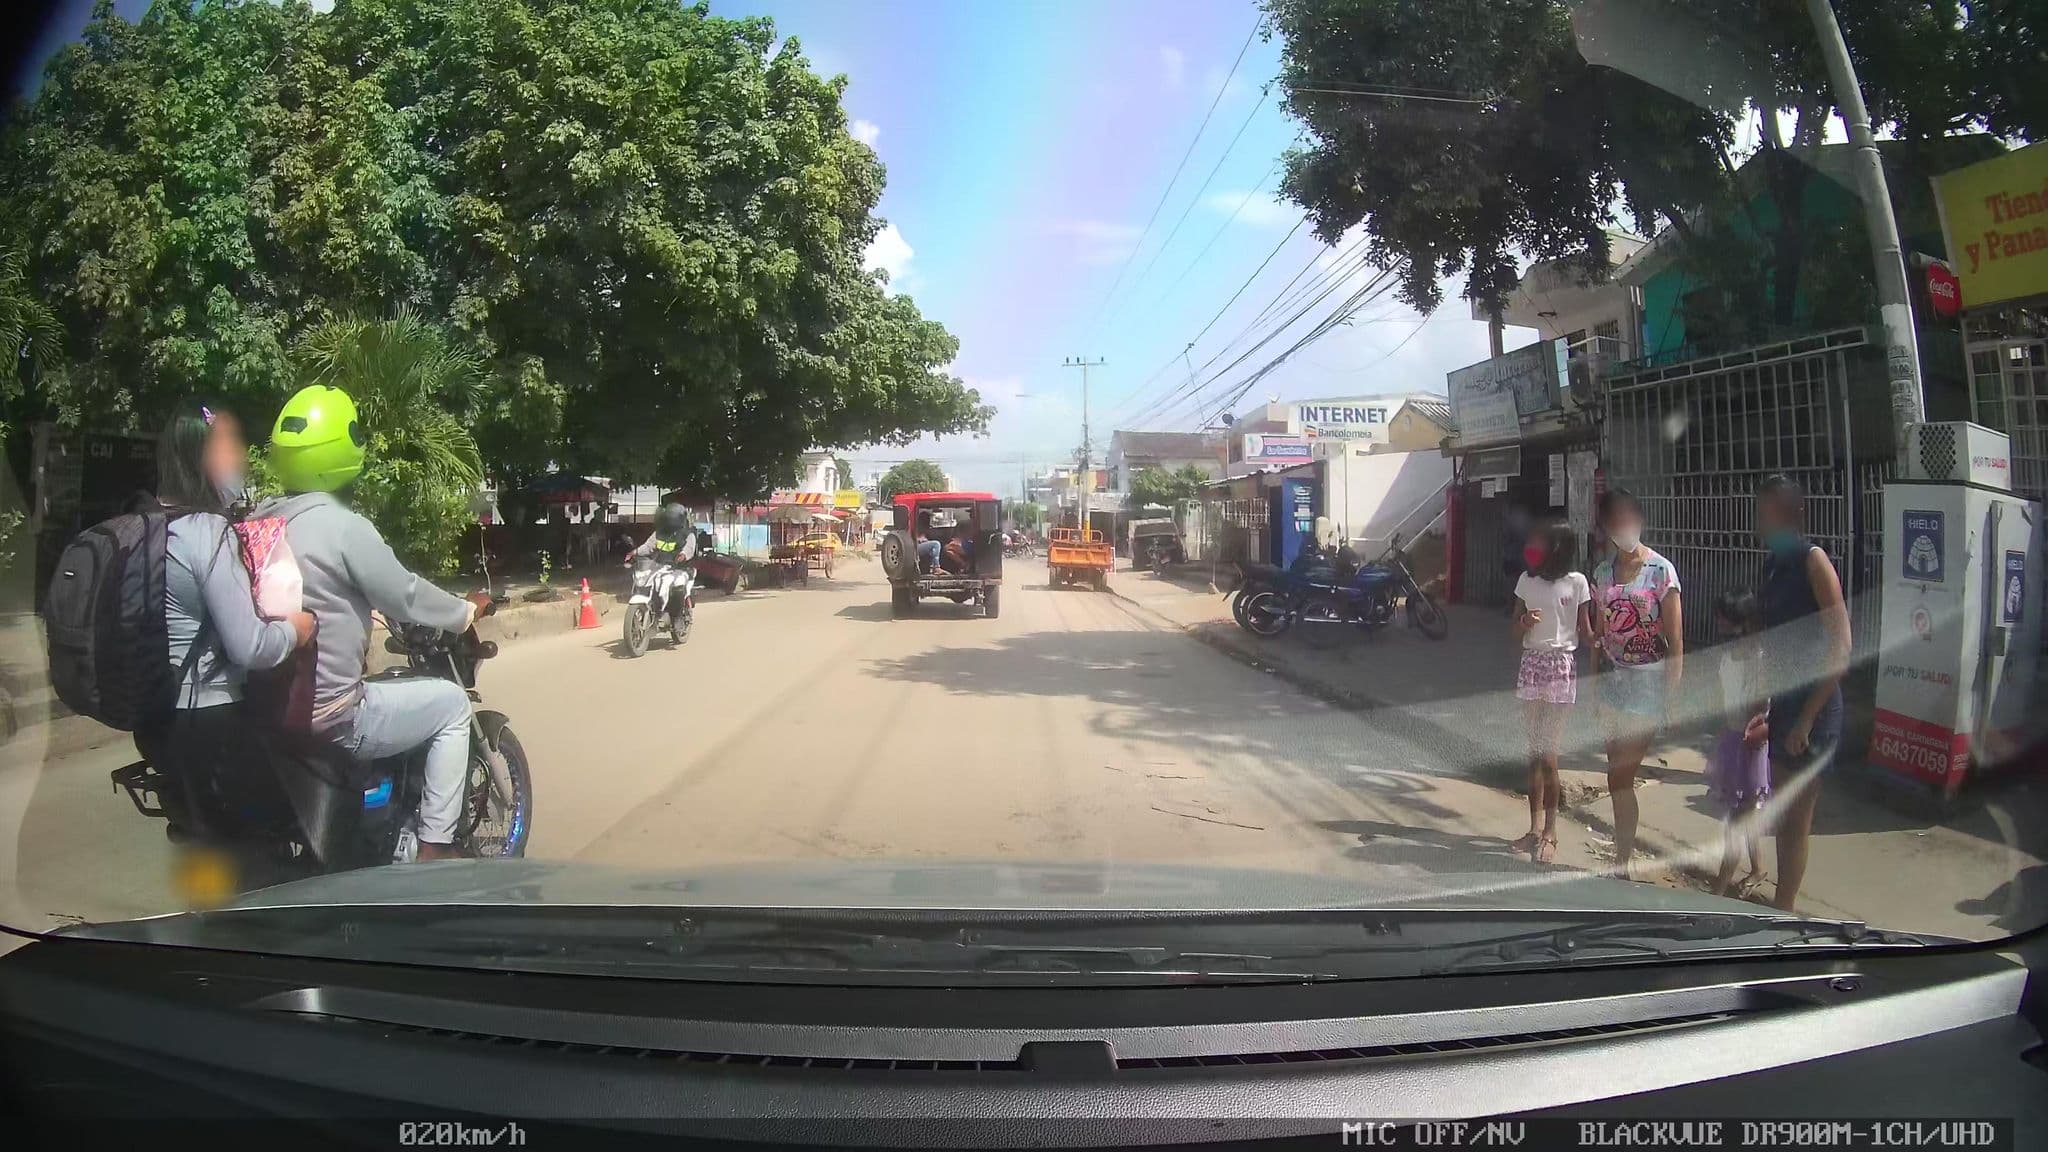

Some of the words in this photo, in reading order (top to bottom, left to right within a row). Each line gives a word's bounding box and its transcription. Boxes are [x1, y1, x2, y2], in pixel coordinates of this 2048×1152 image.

[1964, 242, 1980, 274] y
[1300, 406, 1387, 423] INTERNET
[1909, 519, 1938, 530] HIELO
[1882, 737, 1947, 775] 6437059
